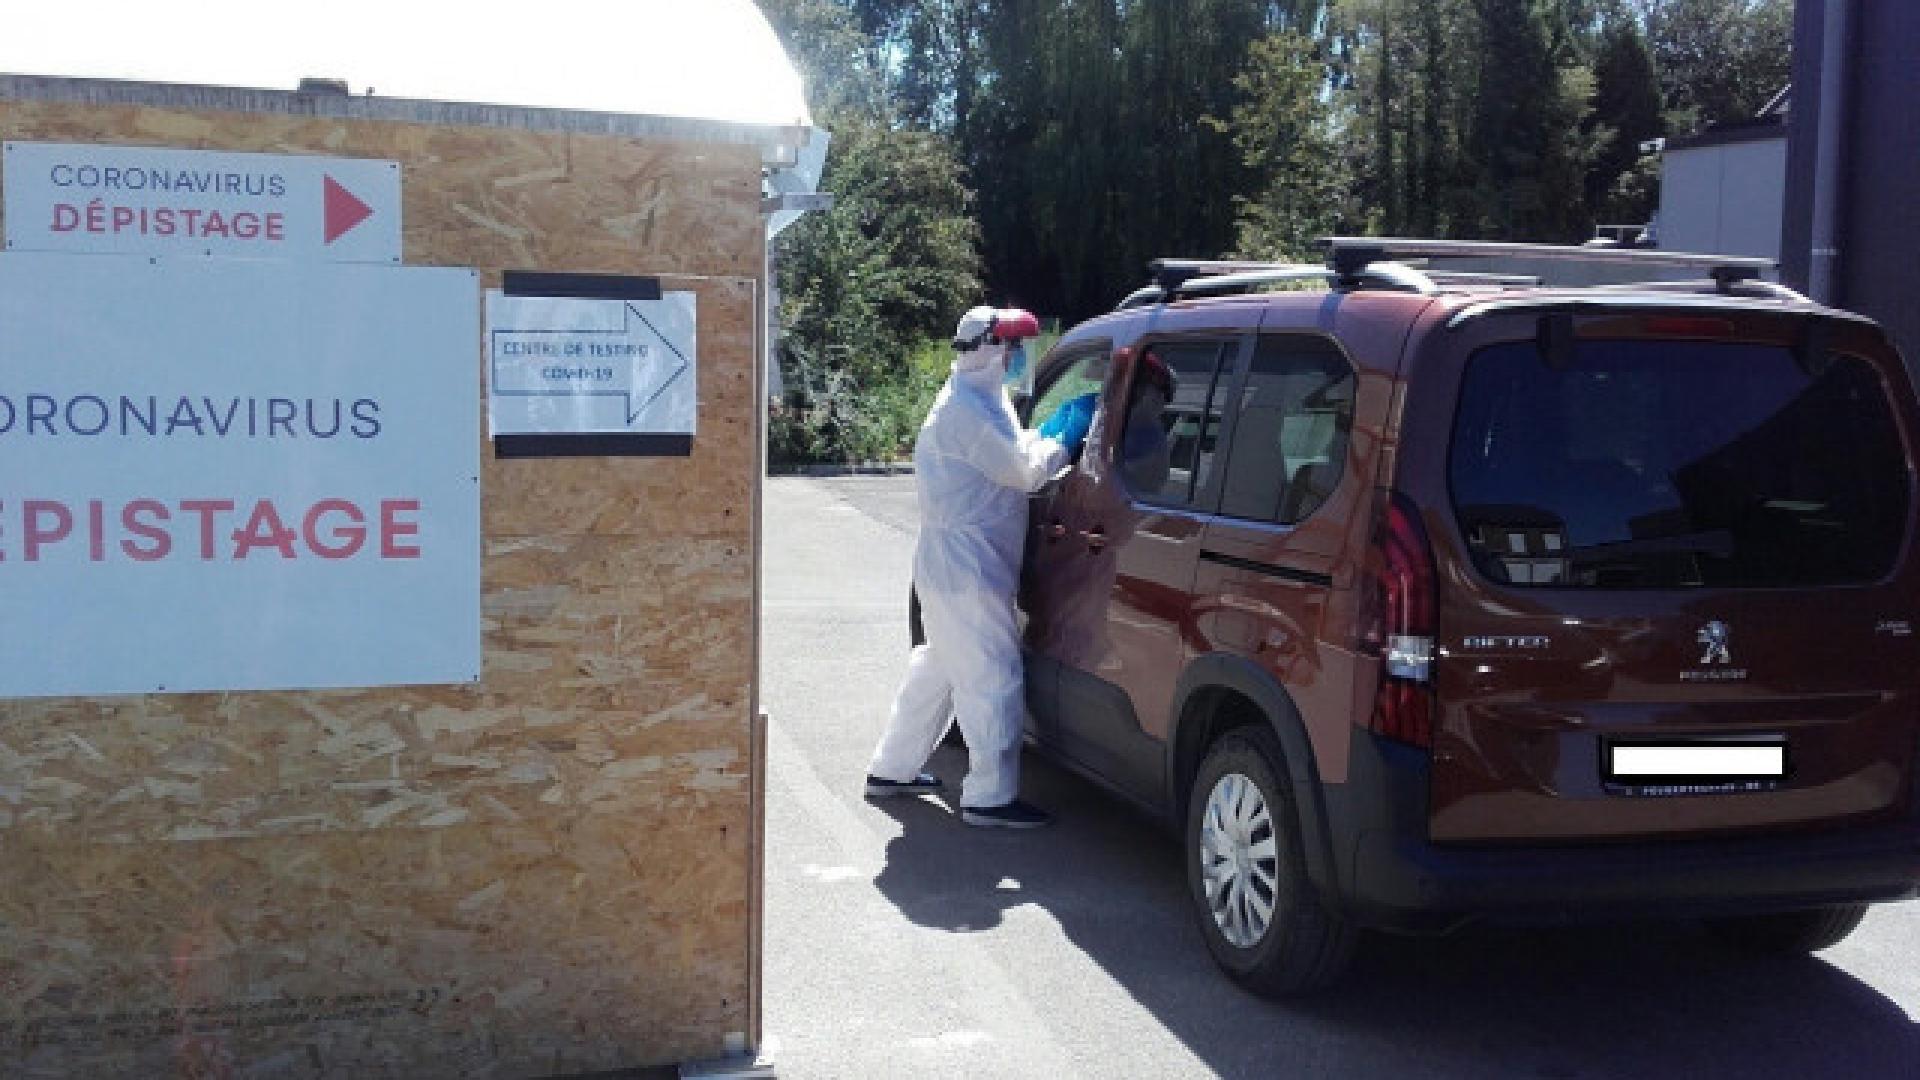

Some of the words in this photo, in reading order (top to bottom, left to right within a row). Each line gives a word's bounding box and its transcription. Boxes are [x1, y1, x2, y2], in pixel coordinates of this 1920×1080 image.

[50, 163, 286, 197] CORONAVIRUS
[50, 198, 285, 241] DÉPISTAGE
[503, 341, 556, 355] CENTRE
[564, 342, 583, 356] DE
[590, 343, 649, 357] TESTING
[542, 366, 613, 381] COVID-19
[0, 496, 422, 562] PISTAGE
